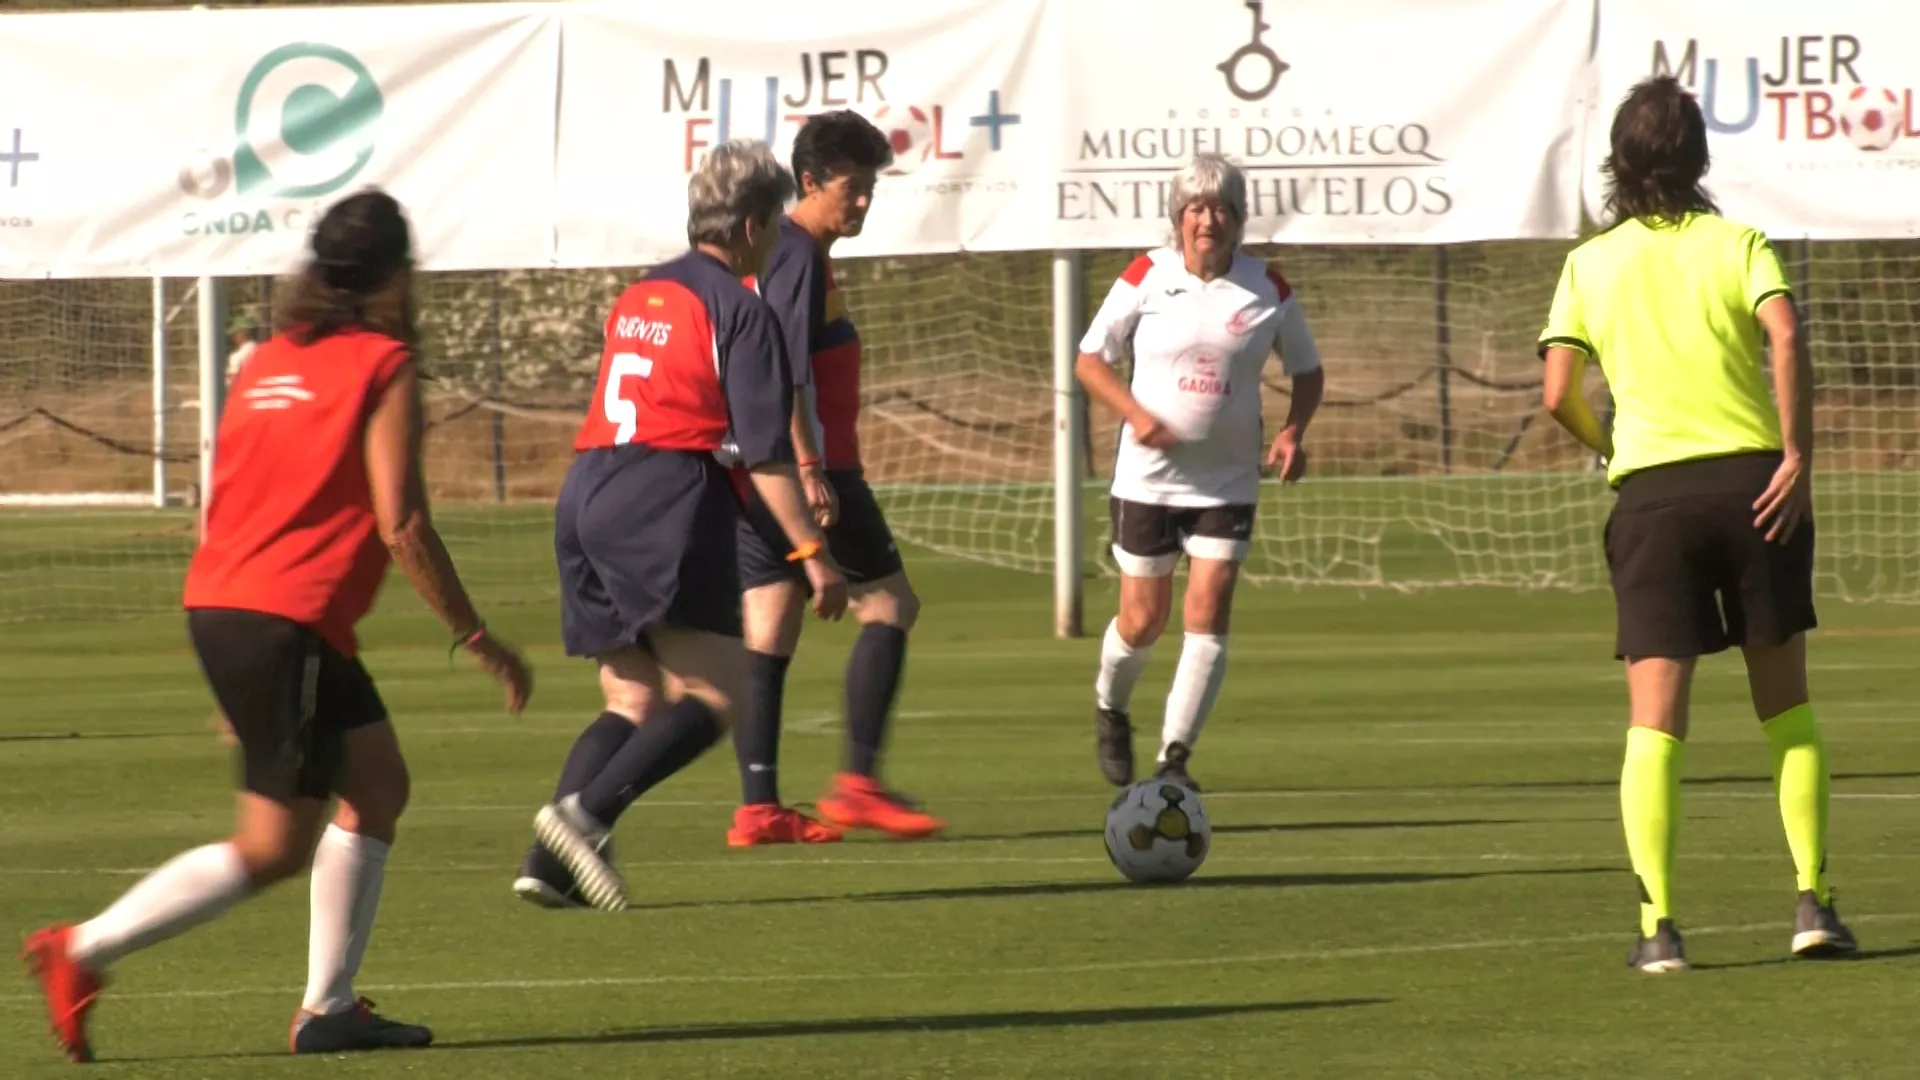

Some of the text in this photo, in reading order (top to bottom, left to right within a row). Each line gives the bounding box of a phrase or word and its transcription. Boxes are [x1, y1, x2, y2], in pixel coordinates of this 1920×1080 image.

[661, 48, 890, 140] MUJER
[1652, 34, 1863, 128] MUJER
[1078, 123, 1448, 162] MIGUEL DOMECQ
[1056, 176, 1454, 220] ENTHUELOS
[604, 352, 654, 445] 5
[1177, 376, 1233, 396] GADIRA
